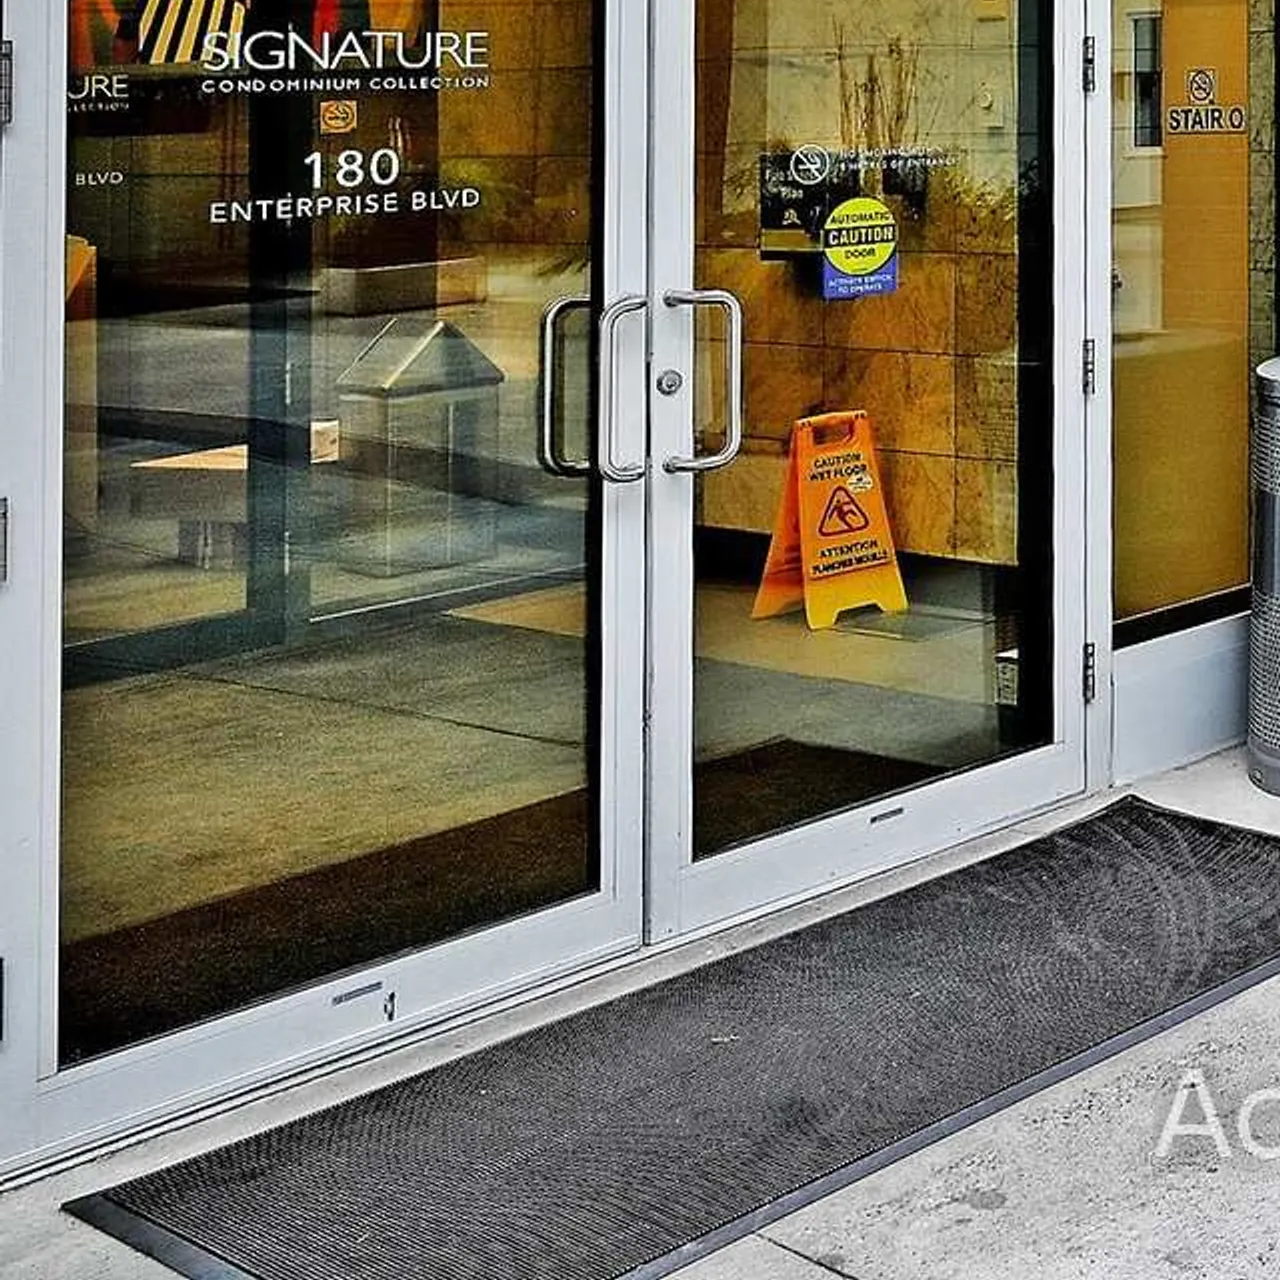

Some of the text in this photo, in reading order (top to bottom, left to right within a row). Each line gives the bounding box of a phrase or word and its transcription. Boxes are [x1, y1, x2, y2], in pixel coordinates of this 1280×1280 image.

[202, 31, 489, 70] SIGNATURE
[202, 76, 489, 93] CONDOMINIUM COLLECTION
[1169, 107, 1224, 131] STAIR
[303, 148, 399, 189] 180
[210, 188, 480, 223] ENTERPRISE BLVD
[830, 211, 891, 225] AUTOMATIC
[829, 226, 894, 246] CAUTION
[844, 247, 877, 260] DOOR
[813, 452, 862, 470] CAUTION
[820, 540, 878, 559] ATTENTION
